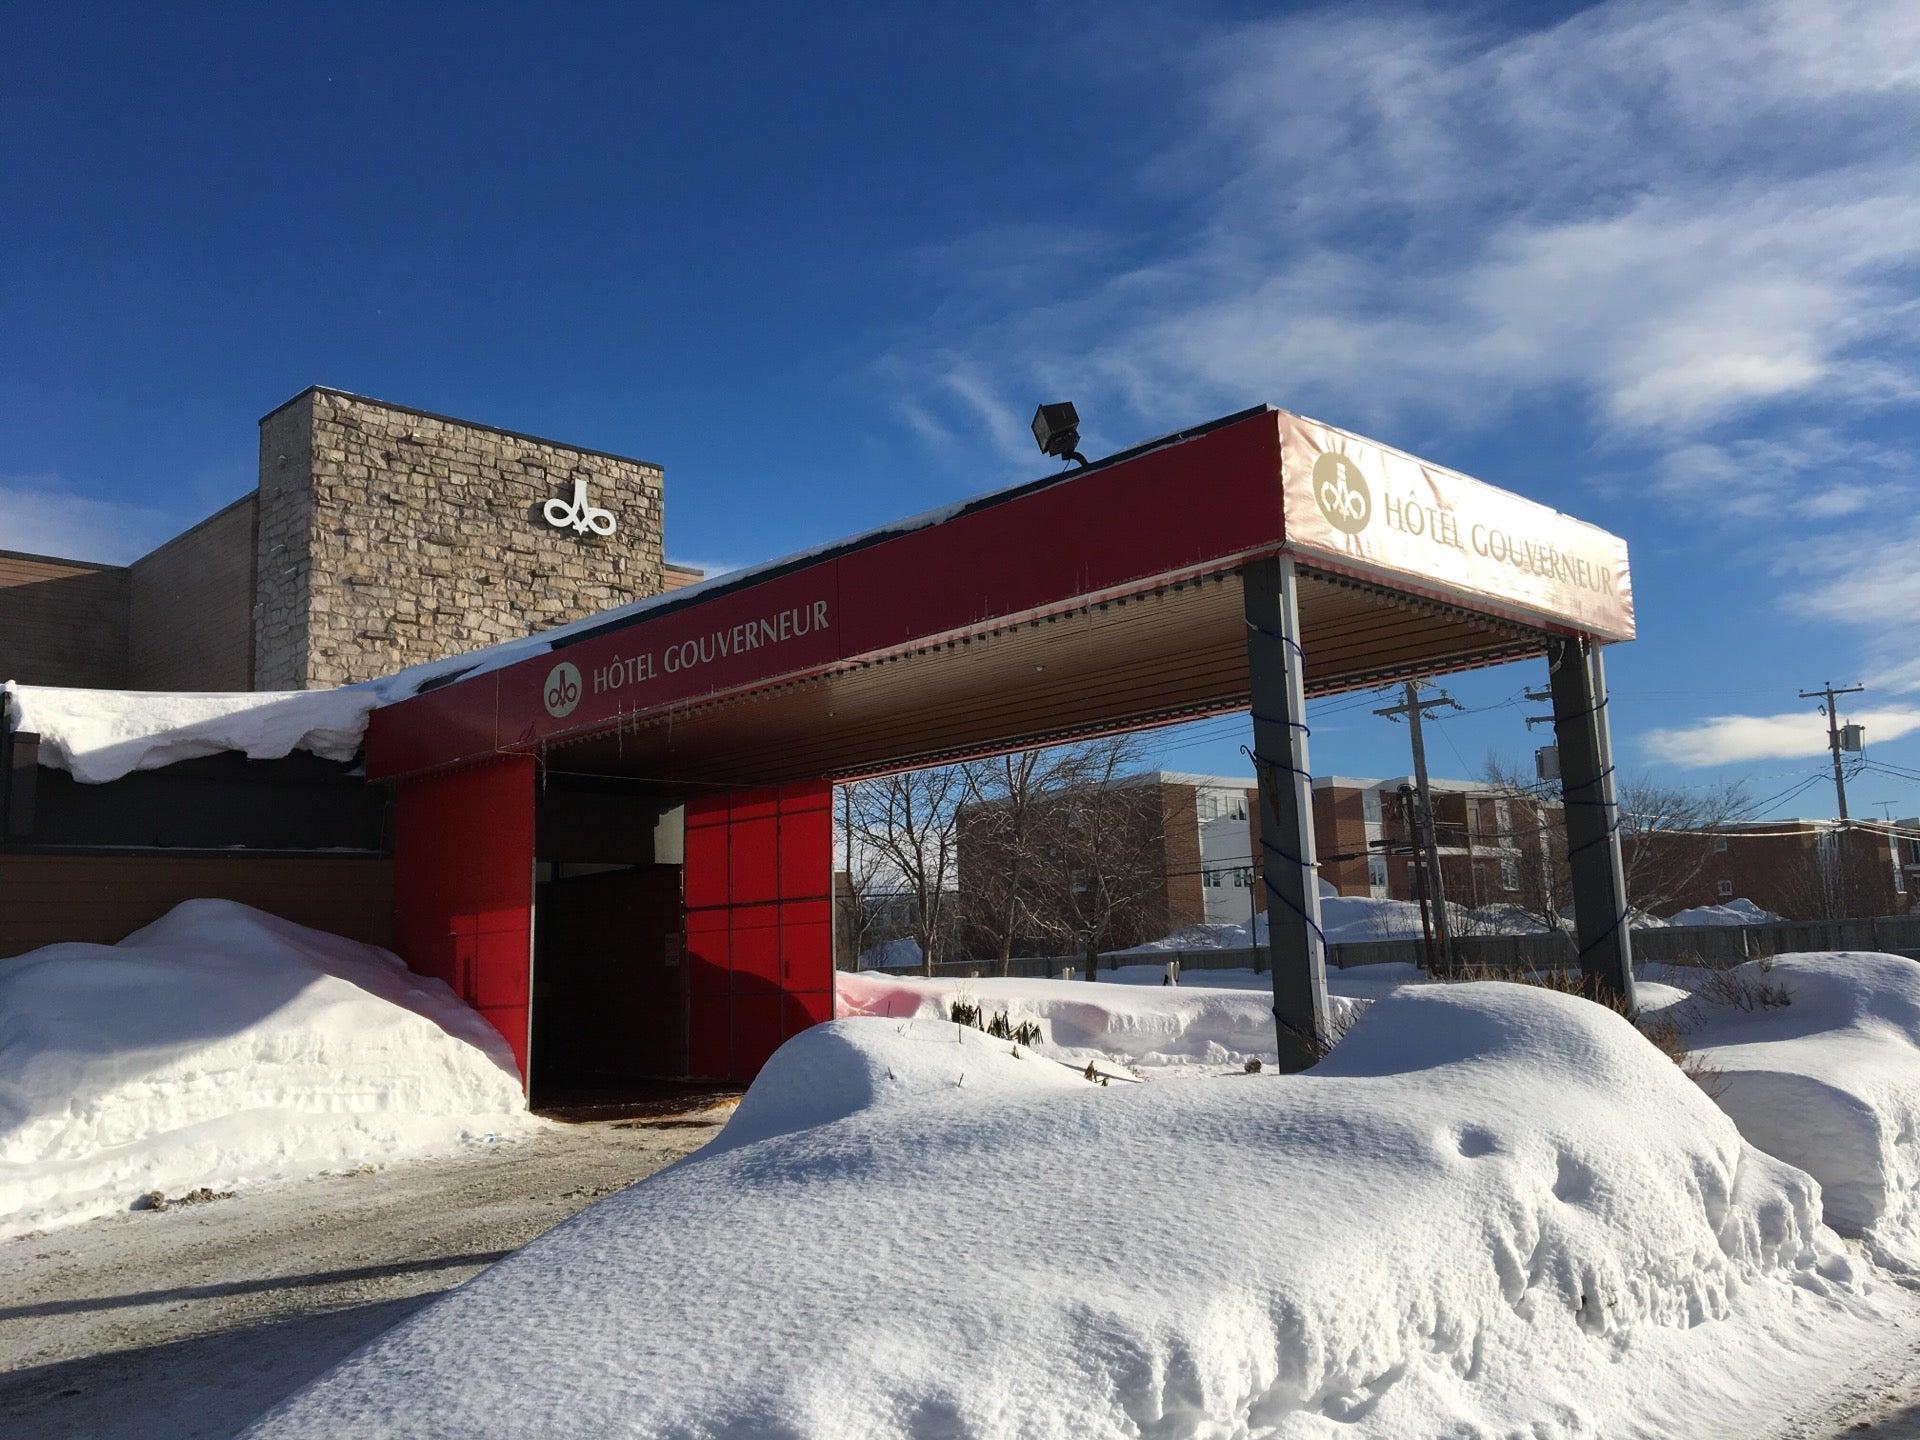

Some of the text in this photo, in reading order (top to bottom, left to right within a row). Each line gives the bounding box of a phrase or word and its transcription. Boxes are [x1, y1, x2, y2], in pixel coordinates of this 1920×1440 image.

[1385, 490, 1613, 595] HÔTEL GOUVERNEUR
[594, 601, 829, 693] HÔTEL GOUVERNEUR
